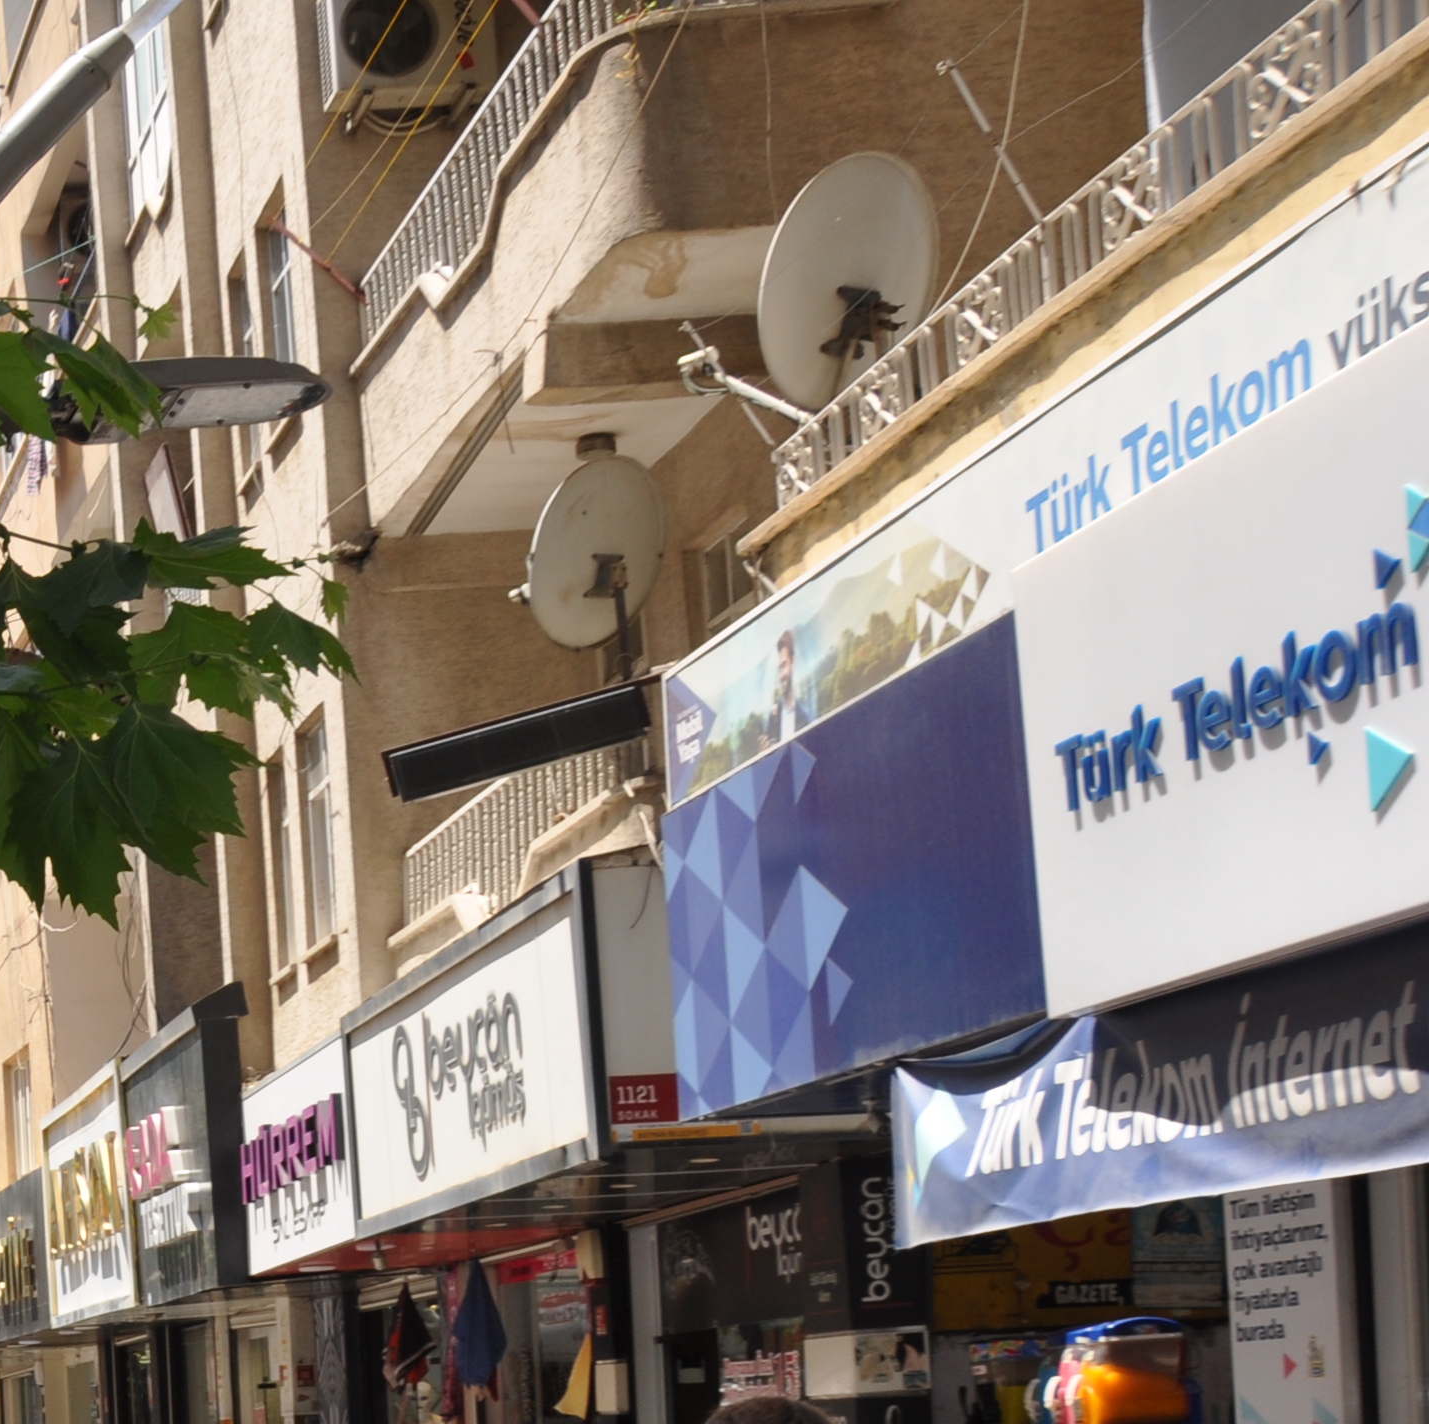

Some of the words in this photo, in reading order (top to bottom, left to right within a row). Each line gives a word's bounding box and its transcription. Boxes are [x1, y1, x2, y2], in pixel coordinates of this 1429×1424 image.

[1026, 454, 1111, 554] Türk
[1121, 338, 1312, 494] Telekom
[1055, 704, 1164, 812] Türk
[1171, 602, 1420, 761] Telekom
[616, 1085, 658, 1105] 1121
[965, 1067, 1045, 1178] Türk
[1054, 1040, 1224, 1160] Telekom
[617, 1110, 658, 1121] SOKAK
[240, 1094, 339, 1205] HÜRREM
[1230, 1199, 1259, 1220] Tüm
[1262, 1190, 1315, 1216] iletişim
[1233, 1259, 1256, 1286] çok
[1260, 1252, 1322, 1278] avantajlı
[1235, 1287, 1299, 1315] fiyatlarla
[1236, 1319, 1285, 1342] burada
